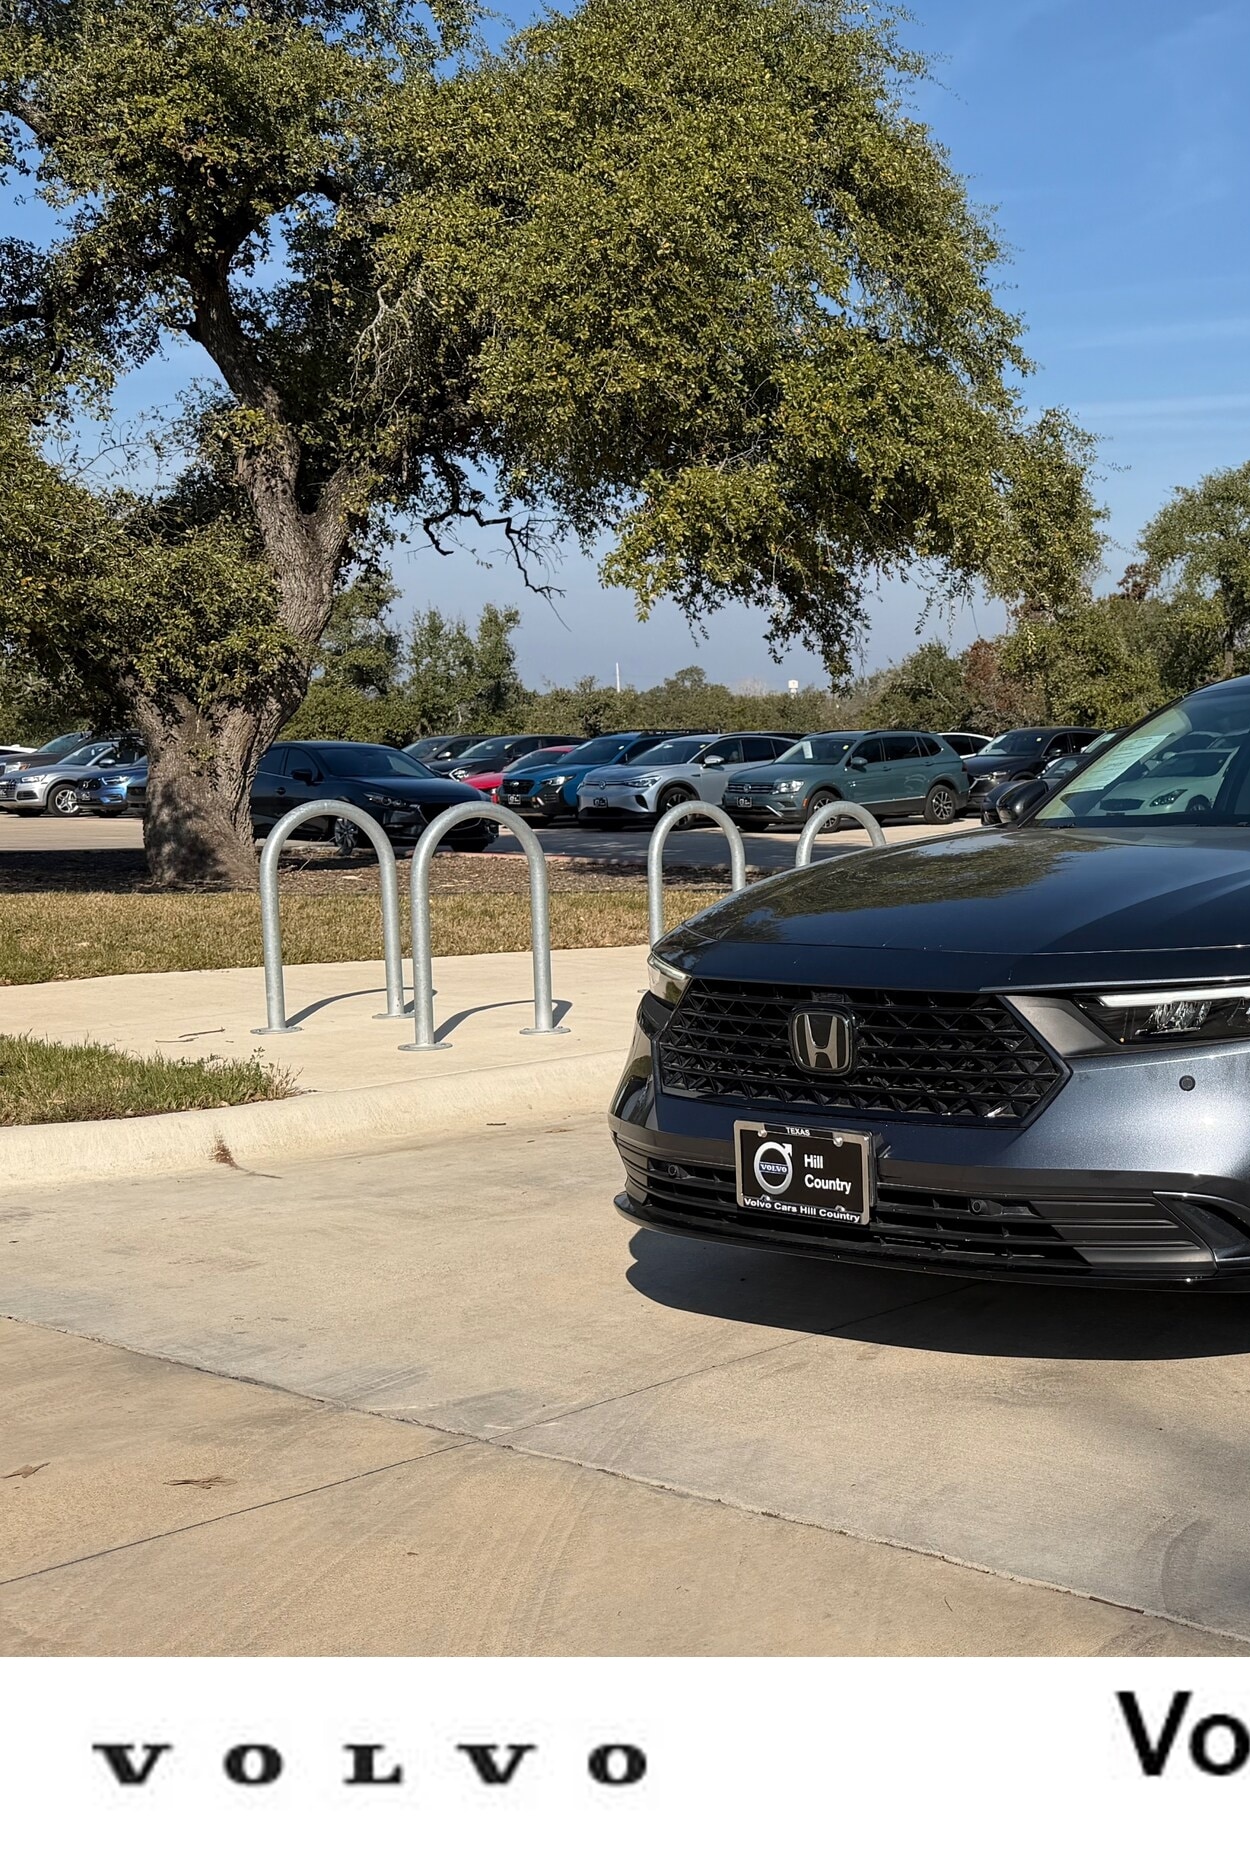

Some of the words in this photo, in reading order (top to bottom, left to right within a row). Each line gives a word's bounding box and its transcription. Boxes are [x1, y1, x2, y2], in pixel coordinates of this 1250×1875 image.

[785, 1127, 811, 1136] TEXAS
[760, 1163, 788, 1173] VOLVO
[804, 1154, 824, 1169] Hill
[804, 1174, 852, 1195] Country
[743, 1198, 772, 1209] Volvo
[774, 1202, 797, 1213] Cars
[800, 1206, 816, 1216] Hill
[819, 1209, 861, 1223] Country
